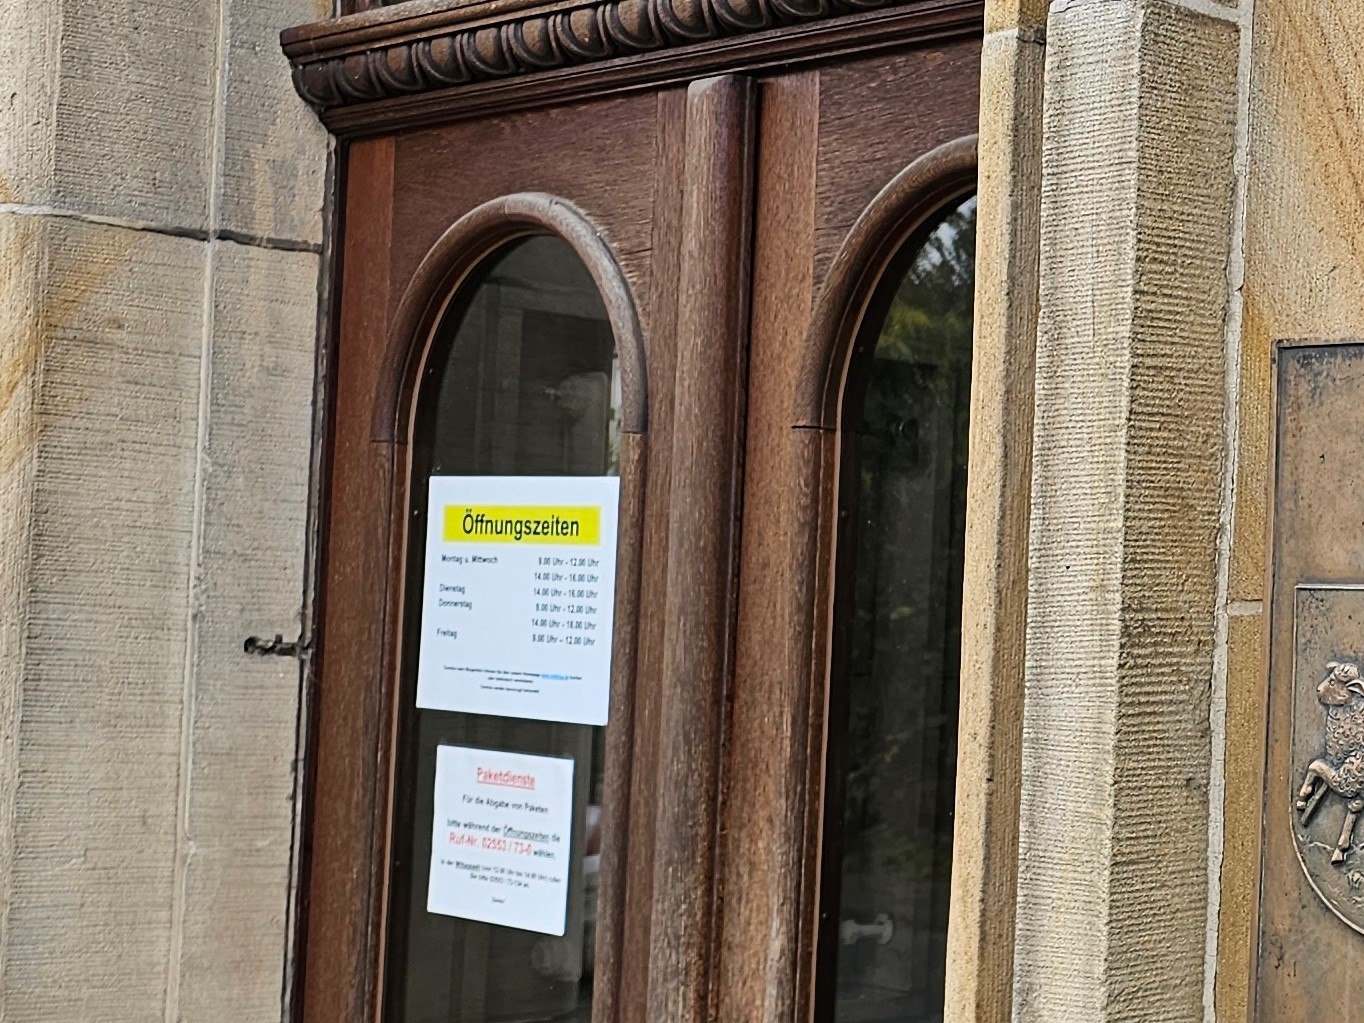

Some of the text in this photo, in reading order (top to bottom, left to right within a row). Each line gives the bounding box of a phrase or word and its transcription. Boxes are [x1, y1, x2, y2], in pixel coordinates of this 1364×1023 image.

[462, 508, 580, 540] Öffnungszeiten
[442, 554, 462, 565] Montag
[472, 555, 498, 564] Mittwoch
[553, 557, 564, 566] Uhr
[570, 558, 586, 566] 12.00
[588, 558, 600, 568] Uhr
[534, 572, 550, 580] 14.00
[552, 572, 563, 582] Uhr
[587, 574, 599, 583] Uhr
[439, 583, 466, 595] Dienstag
[534, 588, 549, 596] 14.00
[551, 588, 562, 597] Uhr
[586, 590, 598, 599] Uhr
[438, 598, 472, 610] Donnerstag
[550, 604, 561, 612] Uhr
[568, 604, 583, 614] 12.00
[585, 605, 598, 614] Uhr
[532, 618, 547, 627] 14.00
[549, 619, 560, 628] Uhr
[584, 621, 596, 630] Uhr
[437, 628, 458, 640] Freitag
[547, 634, 558, 643] Uhr
[566, 636, 581, 645] 12.00
[583, 636, 596, 646] Uhr
[477, 767, 536, 787] Paketdienste
